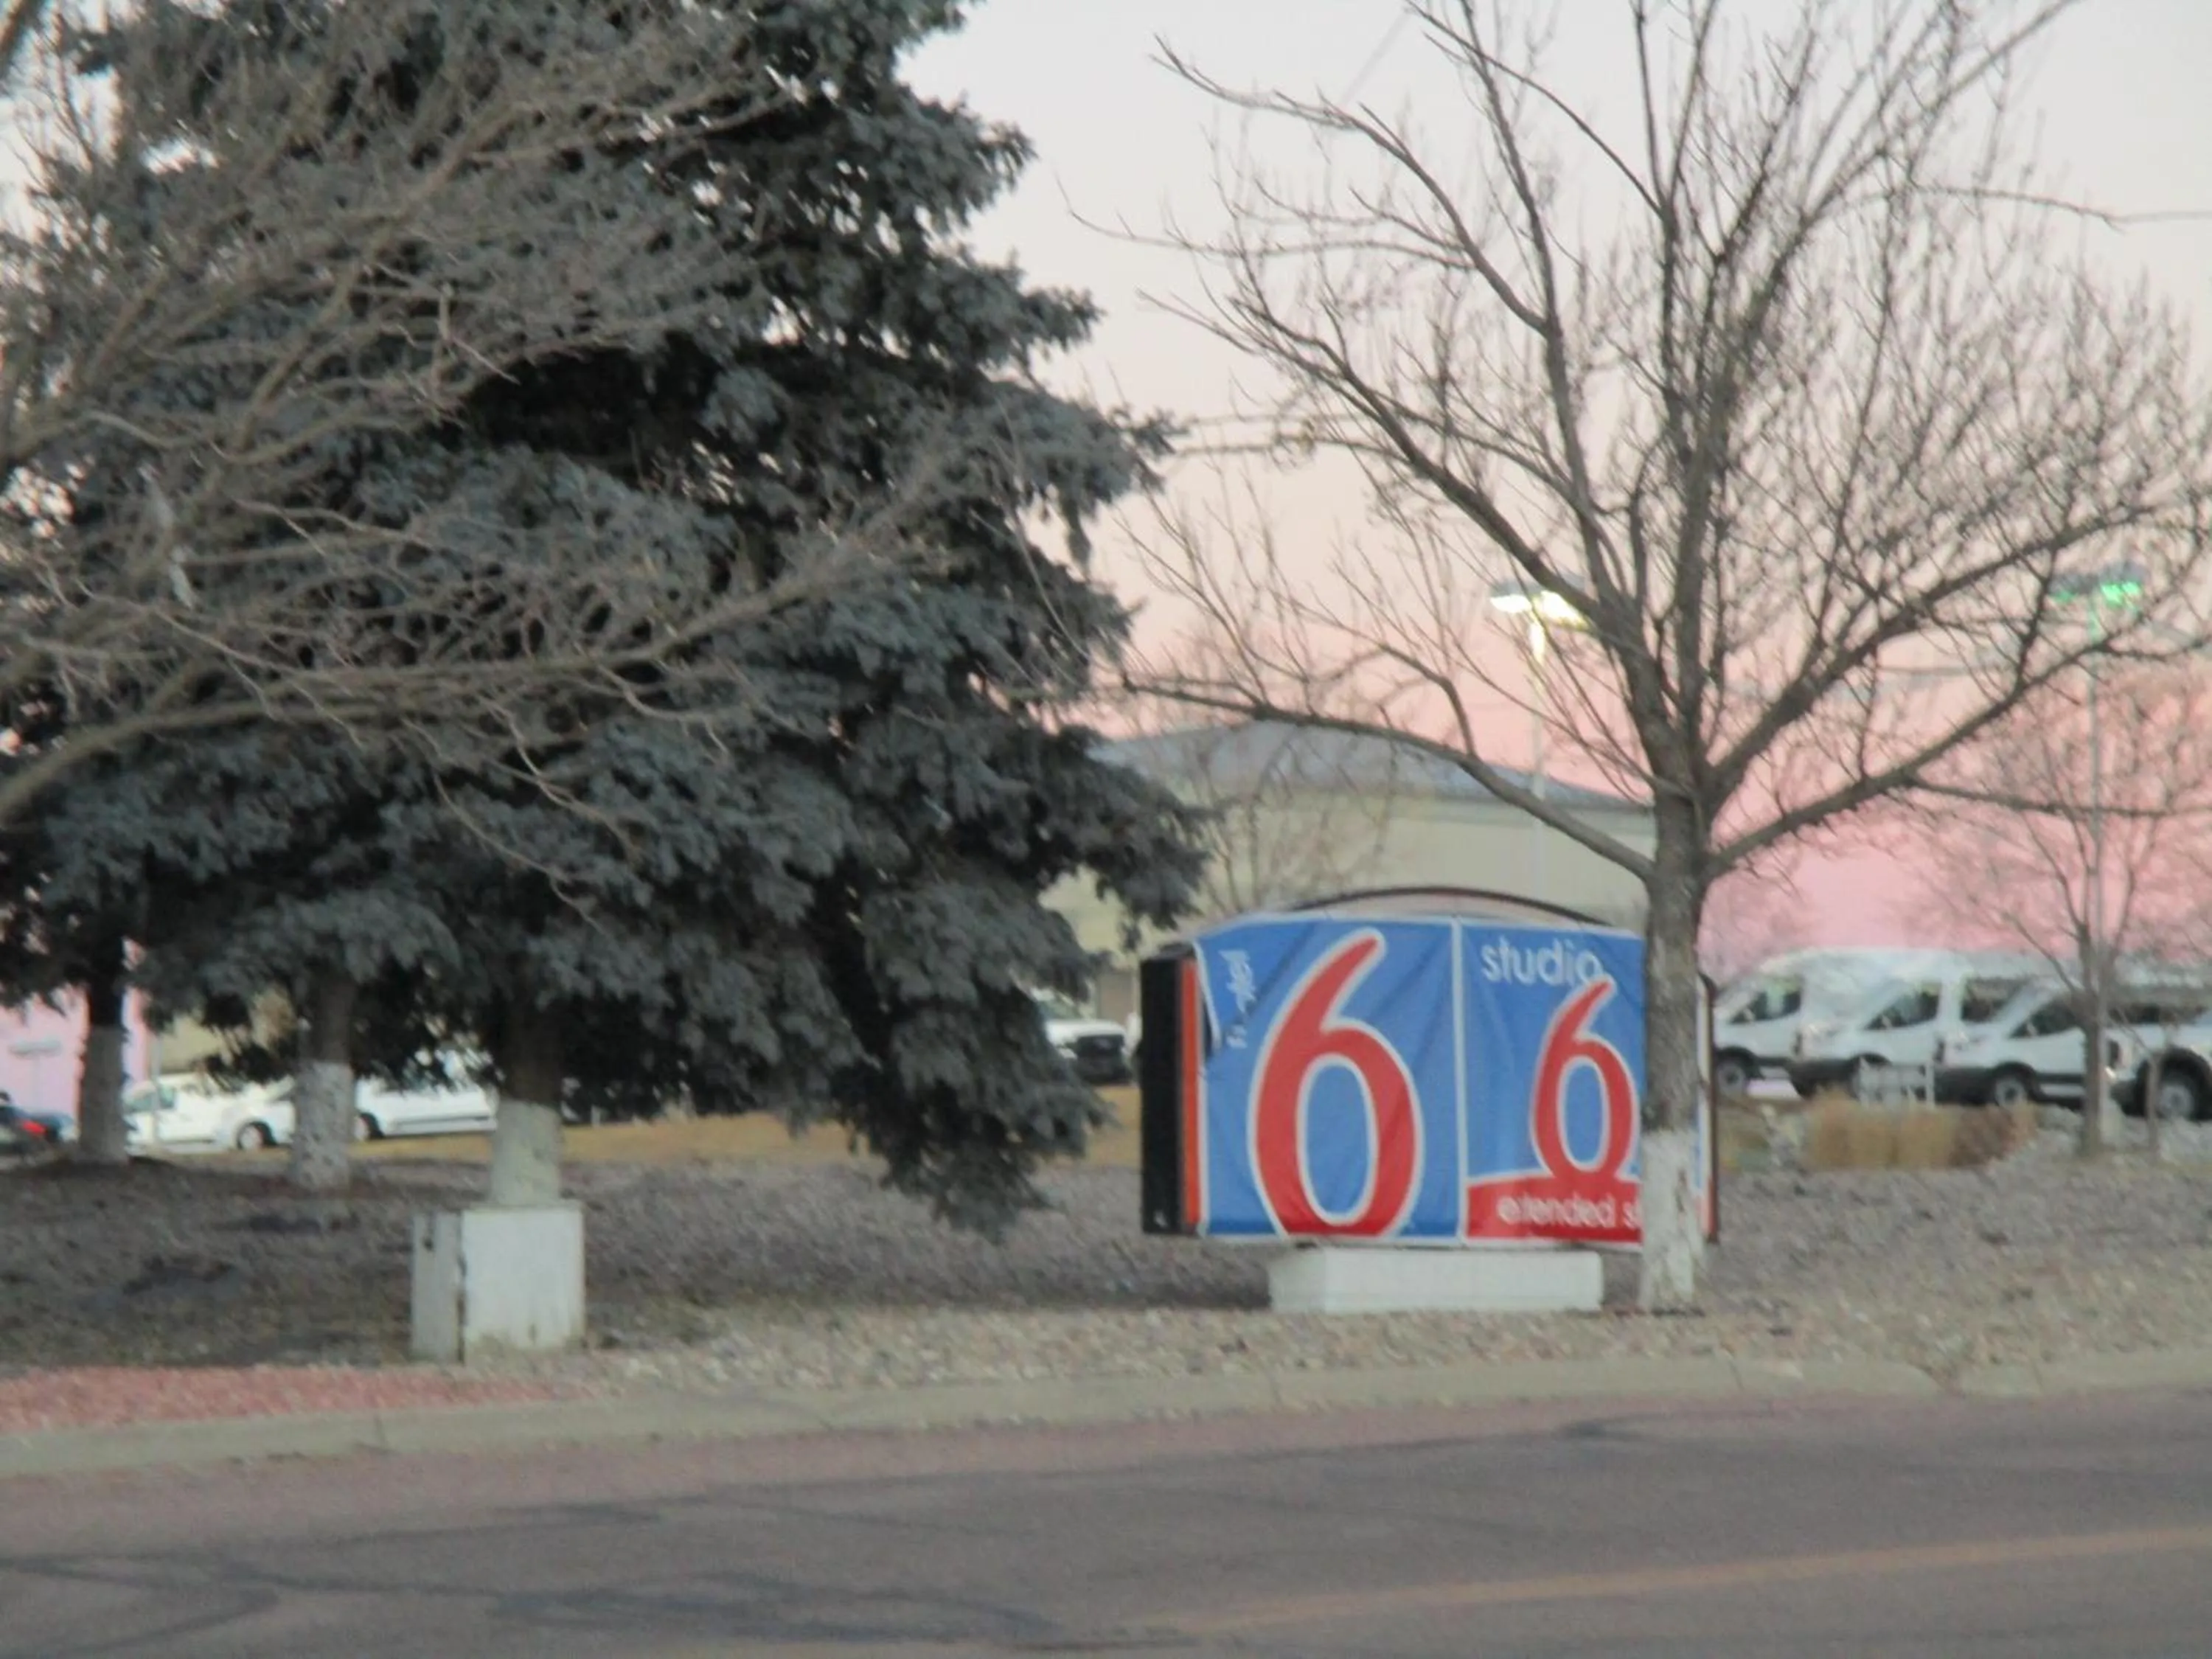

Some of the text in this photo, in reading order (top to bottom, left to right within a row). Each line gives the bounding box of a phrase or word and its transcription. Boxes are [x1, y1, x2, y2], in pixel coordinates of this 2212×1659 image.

[1481, 935, 1604, 987] studio
[1247, 928, 1425, 1239] 6
[1529, 973, 1640, 1181] 6
